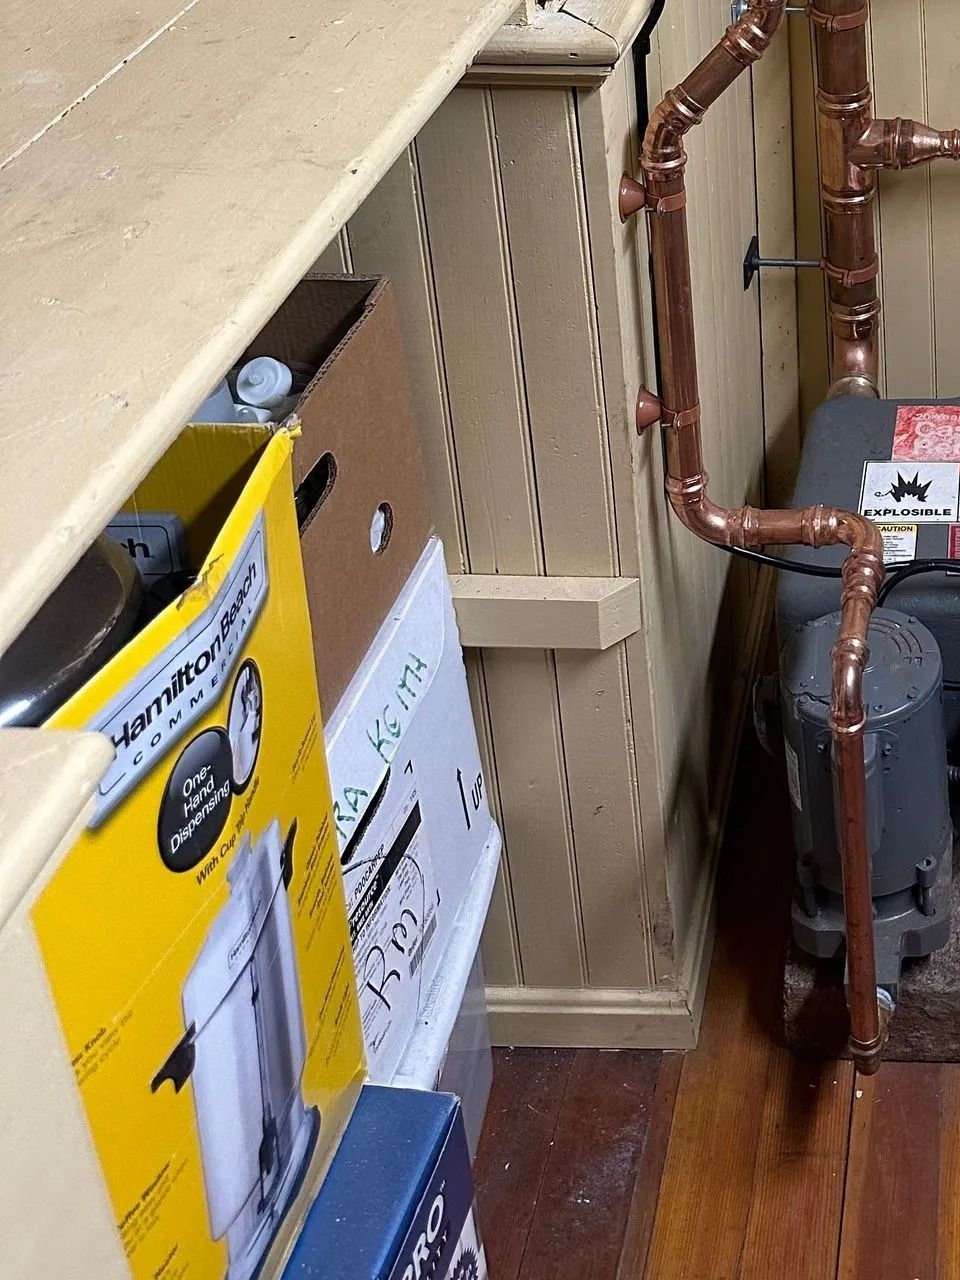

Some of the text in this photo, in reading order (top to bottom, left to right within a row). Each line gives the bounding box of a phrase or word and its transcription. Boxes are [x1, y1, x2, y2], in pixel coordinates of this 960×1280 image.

[864, 508, 952, 517] EXPLOSIBLE
[183, 764, 212, 797] One-
[183, 775, 215, 818] Hand
[471, 772, 483, 810] UP
[170, 779, 230, 854] Dispensing
[196, 856, 219, 886] With
[219, 834, 237, 857] Cup
